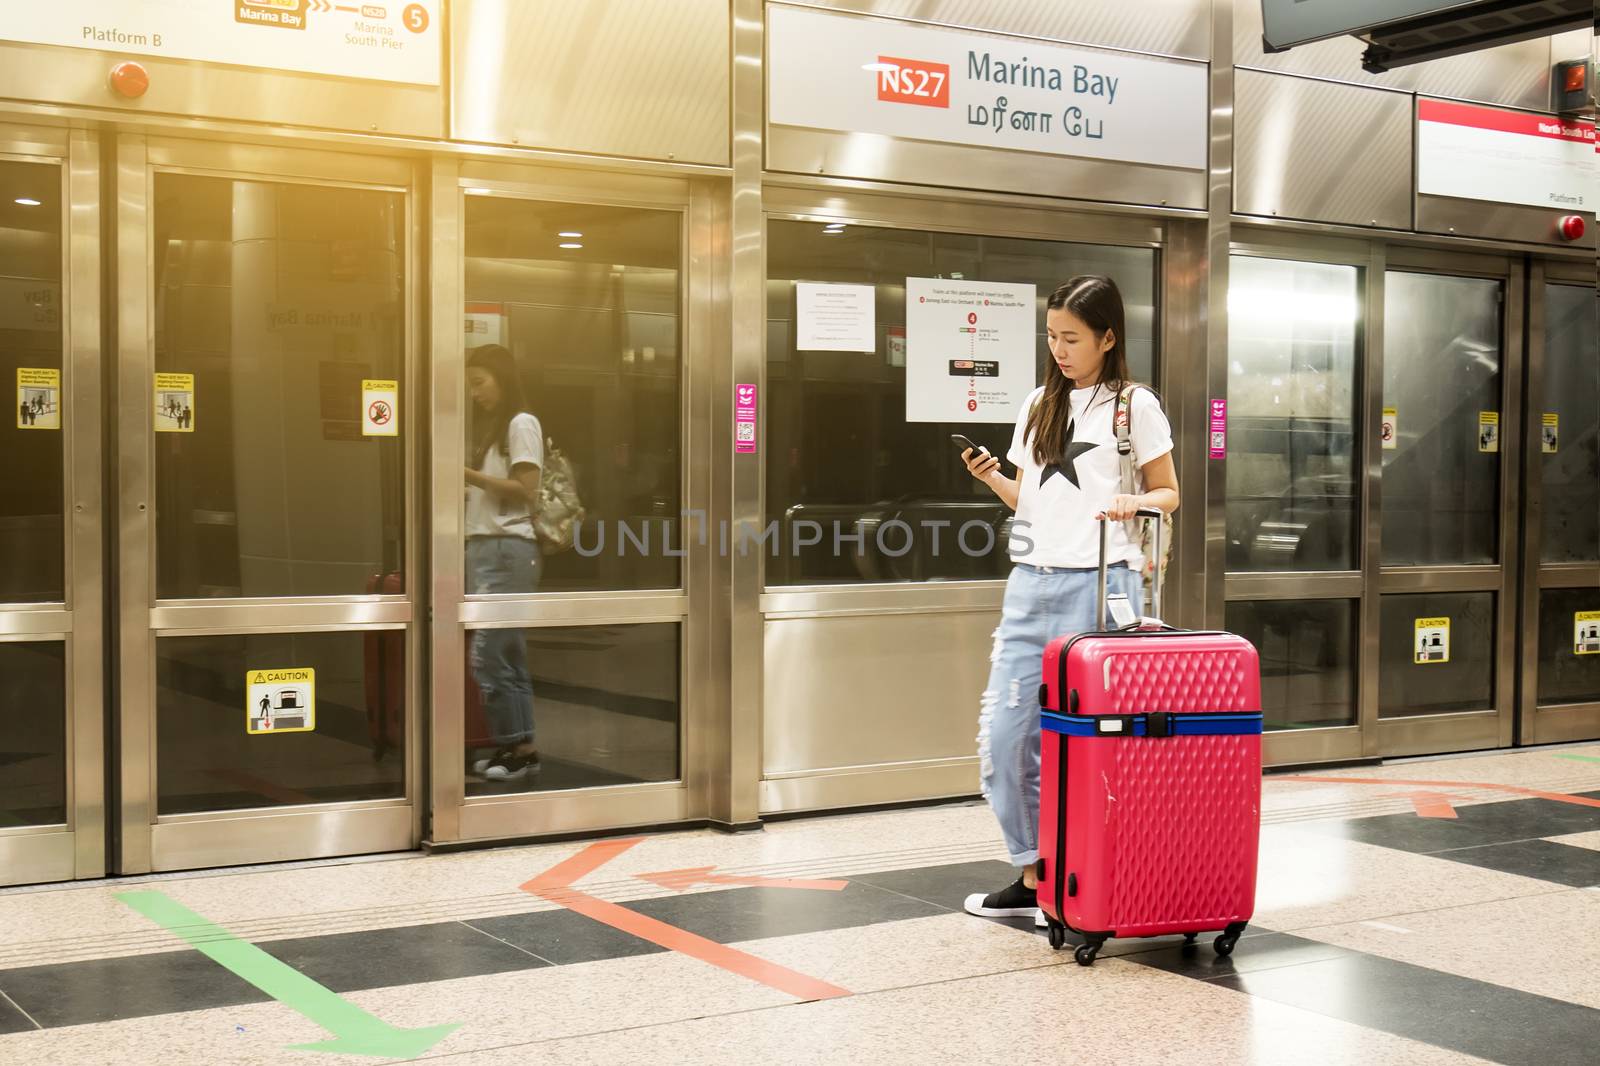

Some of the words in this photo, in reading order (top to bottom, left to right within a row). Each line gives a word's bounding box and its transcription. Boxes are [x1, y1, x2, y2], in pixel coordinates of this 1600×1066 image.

[240, 8, 279, 22] Marina
[281, 13, 302, 27] Bay
[411, 9, 422, 28] 5
[82, 26, 147, 46] Platform
[152, 33, 162, 47] B
[355, 22, 393, 36] Marina
[345, 34, 377, 47] South
[382, 37, 404, 50] Pier
[881, 67, 946, 98] NS27
[968, 51, 1061, 90] Marina
[1074, 66, 1118, 104] Bay
[1538, 123, 1560, 135] North
[1562, 126, 1582, 138] South
[267, 672, 308, 681] CAUTION
